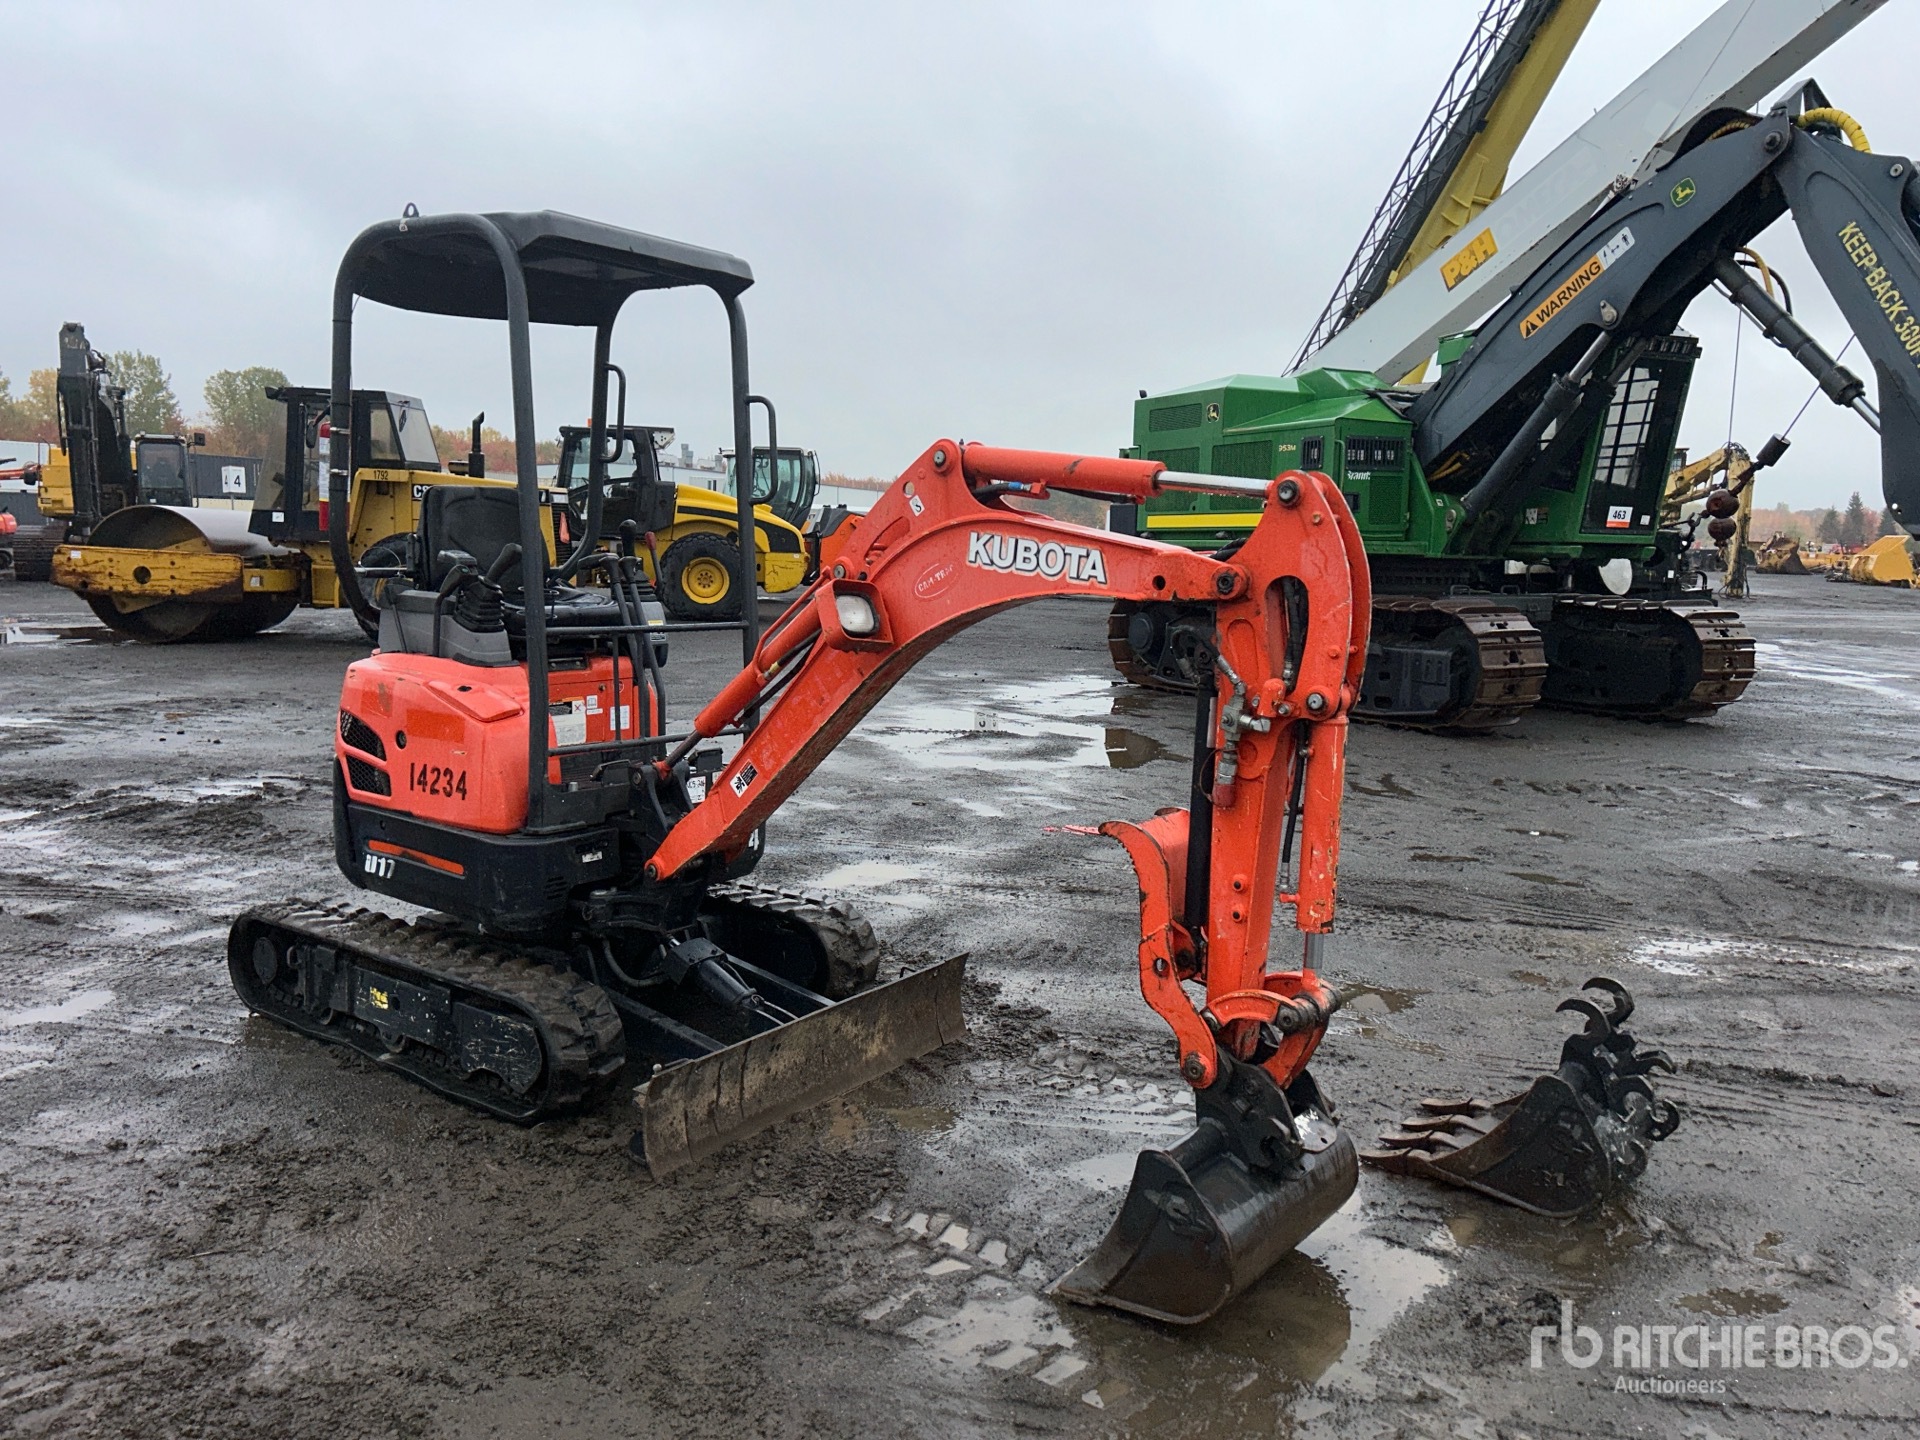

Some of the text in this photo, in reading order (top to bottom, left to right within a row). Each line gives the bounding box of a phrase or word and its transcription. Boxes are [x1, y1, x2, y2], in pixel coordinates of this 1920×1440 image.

[1442, 231, 1496, 286] P&H
[1838, 221, 1878, 268] KEEP
[1865, 266, 1908, 322] BACK
[1536, 261, 1602, 322] WARNING
[233, 474, 241, 488] 4
[373, 470, 389, 481] 1792
[1612, 510, 1627, 520] 463
[968, 531, 1107, 585] KUBOTA
[409, 762, 468, 801] 14234
[364, 853, 396, 879] U17
